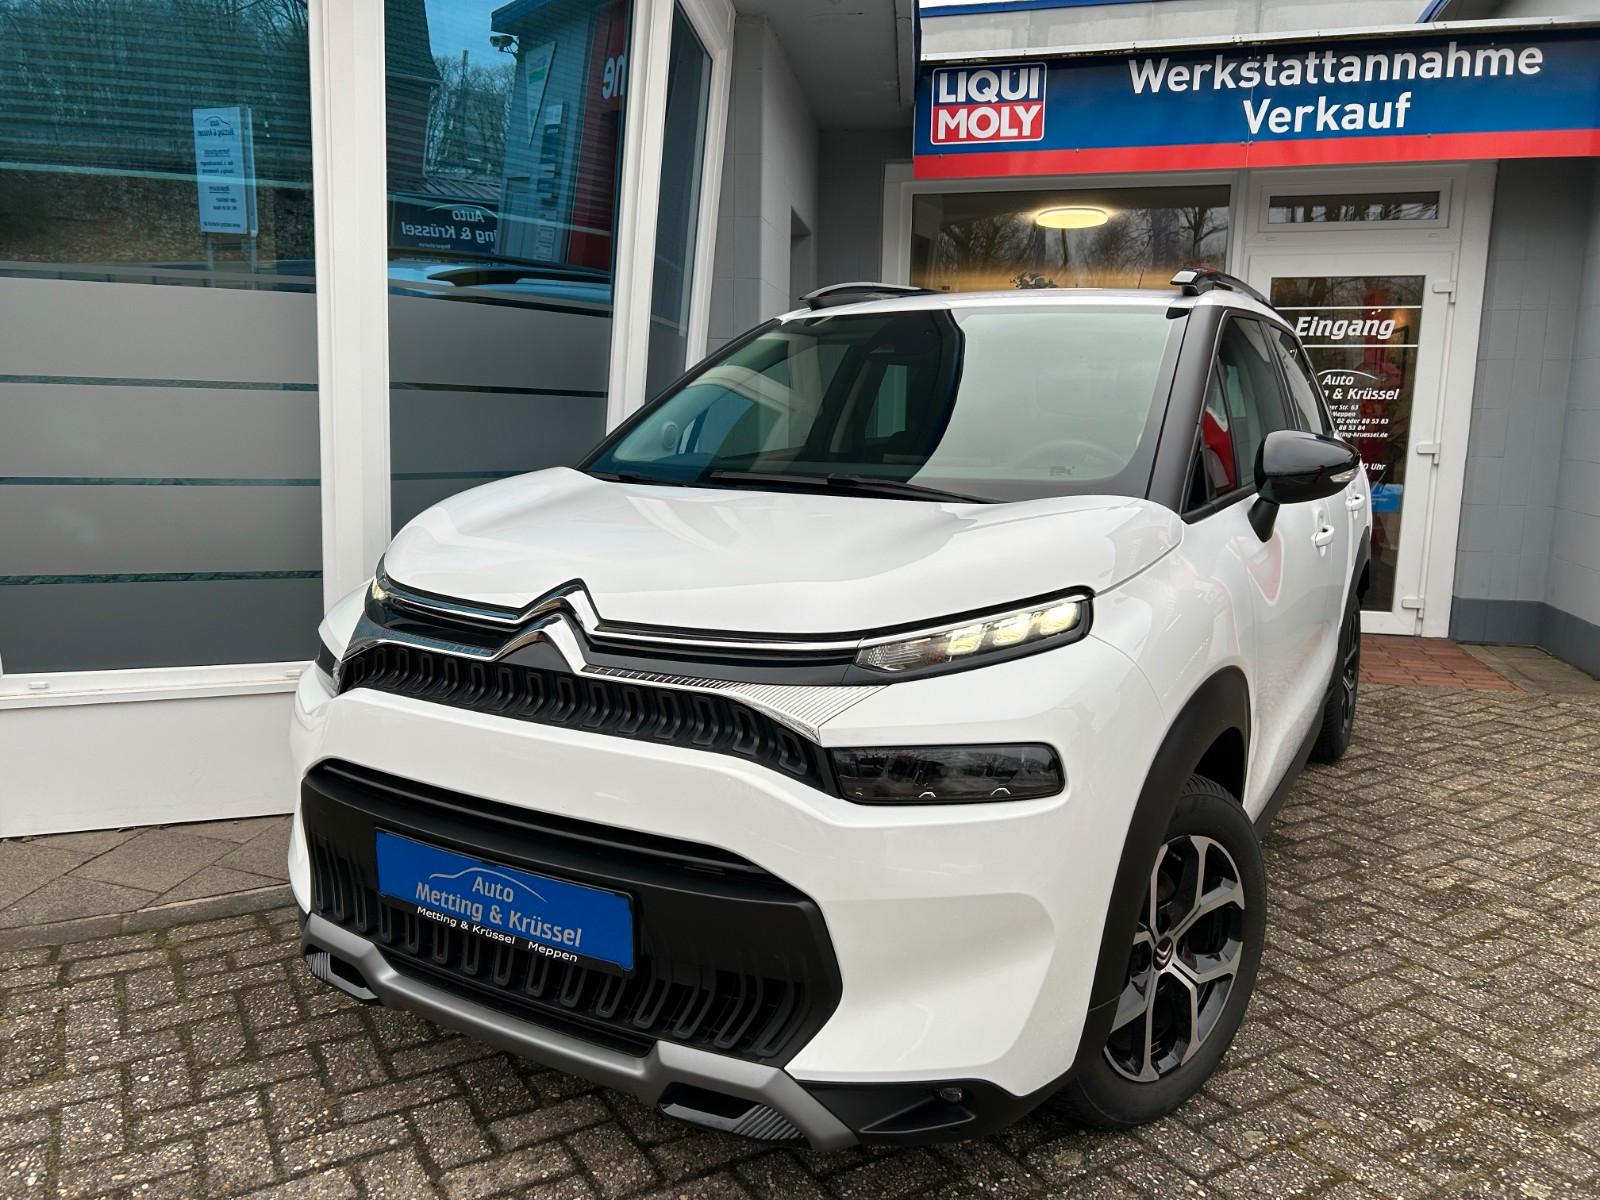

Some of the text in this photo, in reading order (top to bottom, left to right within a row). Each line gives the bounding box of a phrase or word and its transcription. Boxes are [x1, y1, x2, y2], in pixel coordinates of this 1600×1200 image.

[939, 67, 1040, 103] LIQUI
[1128, 41, 1543, 95] Werkstattannahme
[938, 105, 1042, 140] MOLY
[1243, 91, 1412, 135] Verkauf
[1295, 316, 1396, 340] Eingang
[1322, 374, 1354, 386] Auto
[1332, 387, 1344, 400] &
[1347, 387, 1400, 400] Krüssel
[1370, 463, 1386, 471] Uhr
[472, 875, 514, 903] Auto
[415, 881, 582, 948] Metting & Krüssel
[417, 905, 578, 963] Metting & Krüssel Meppen
